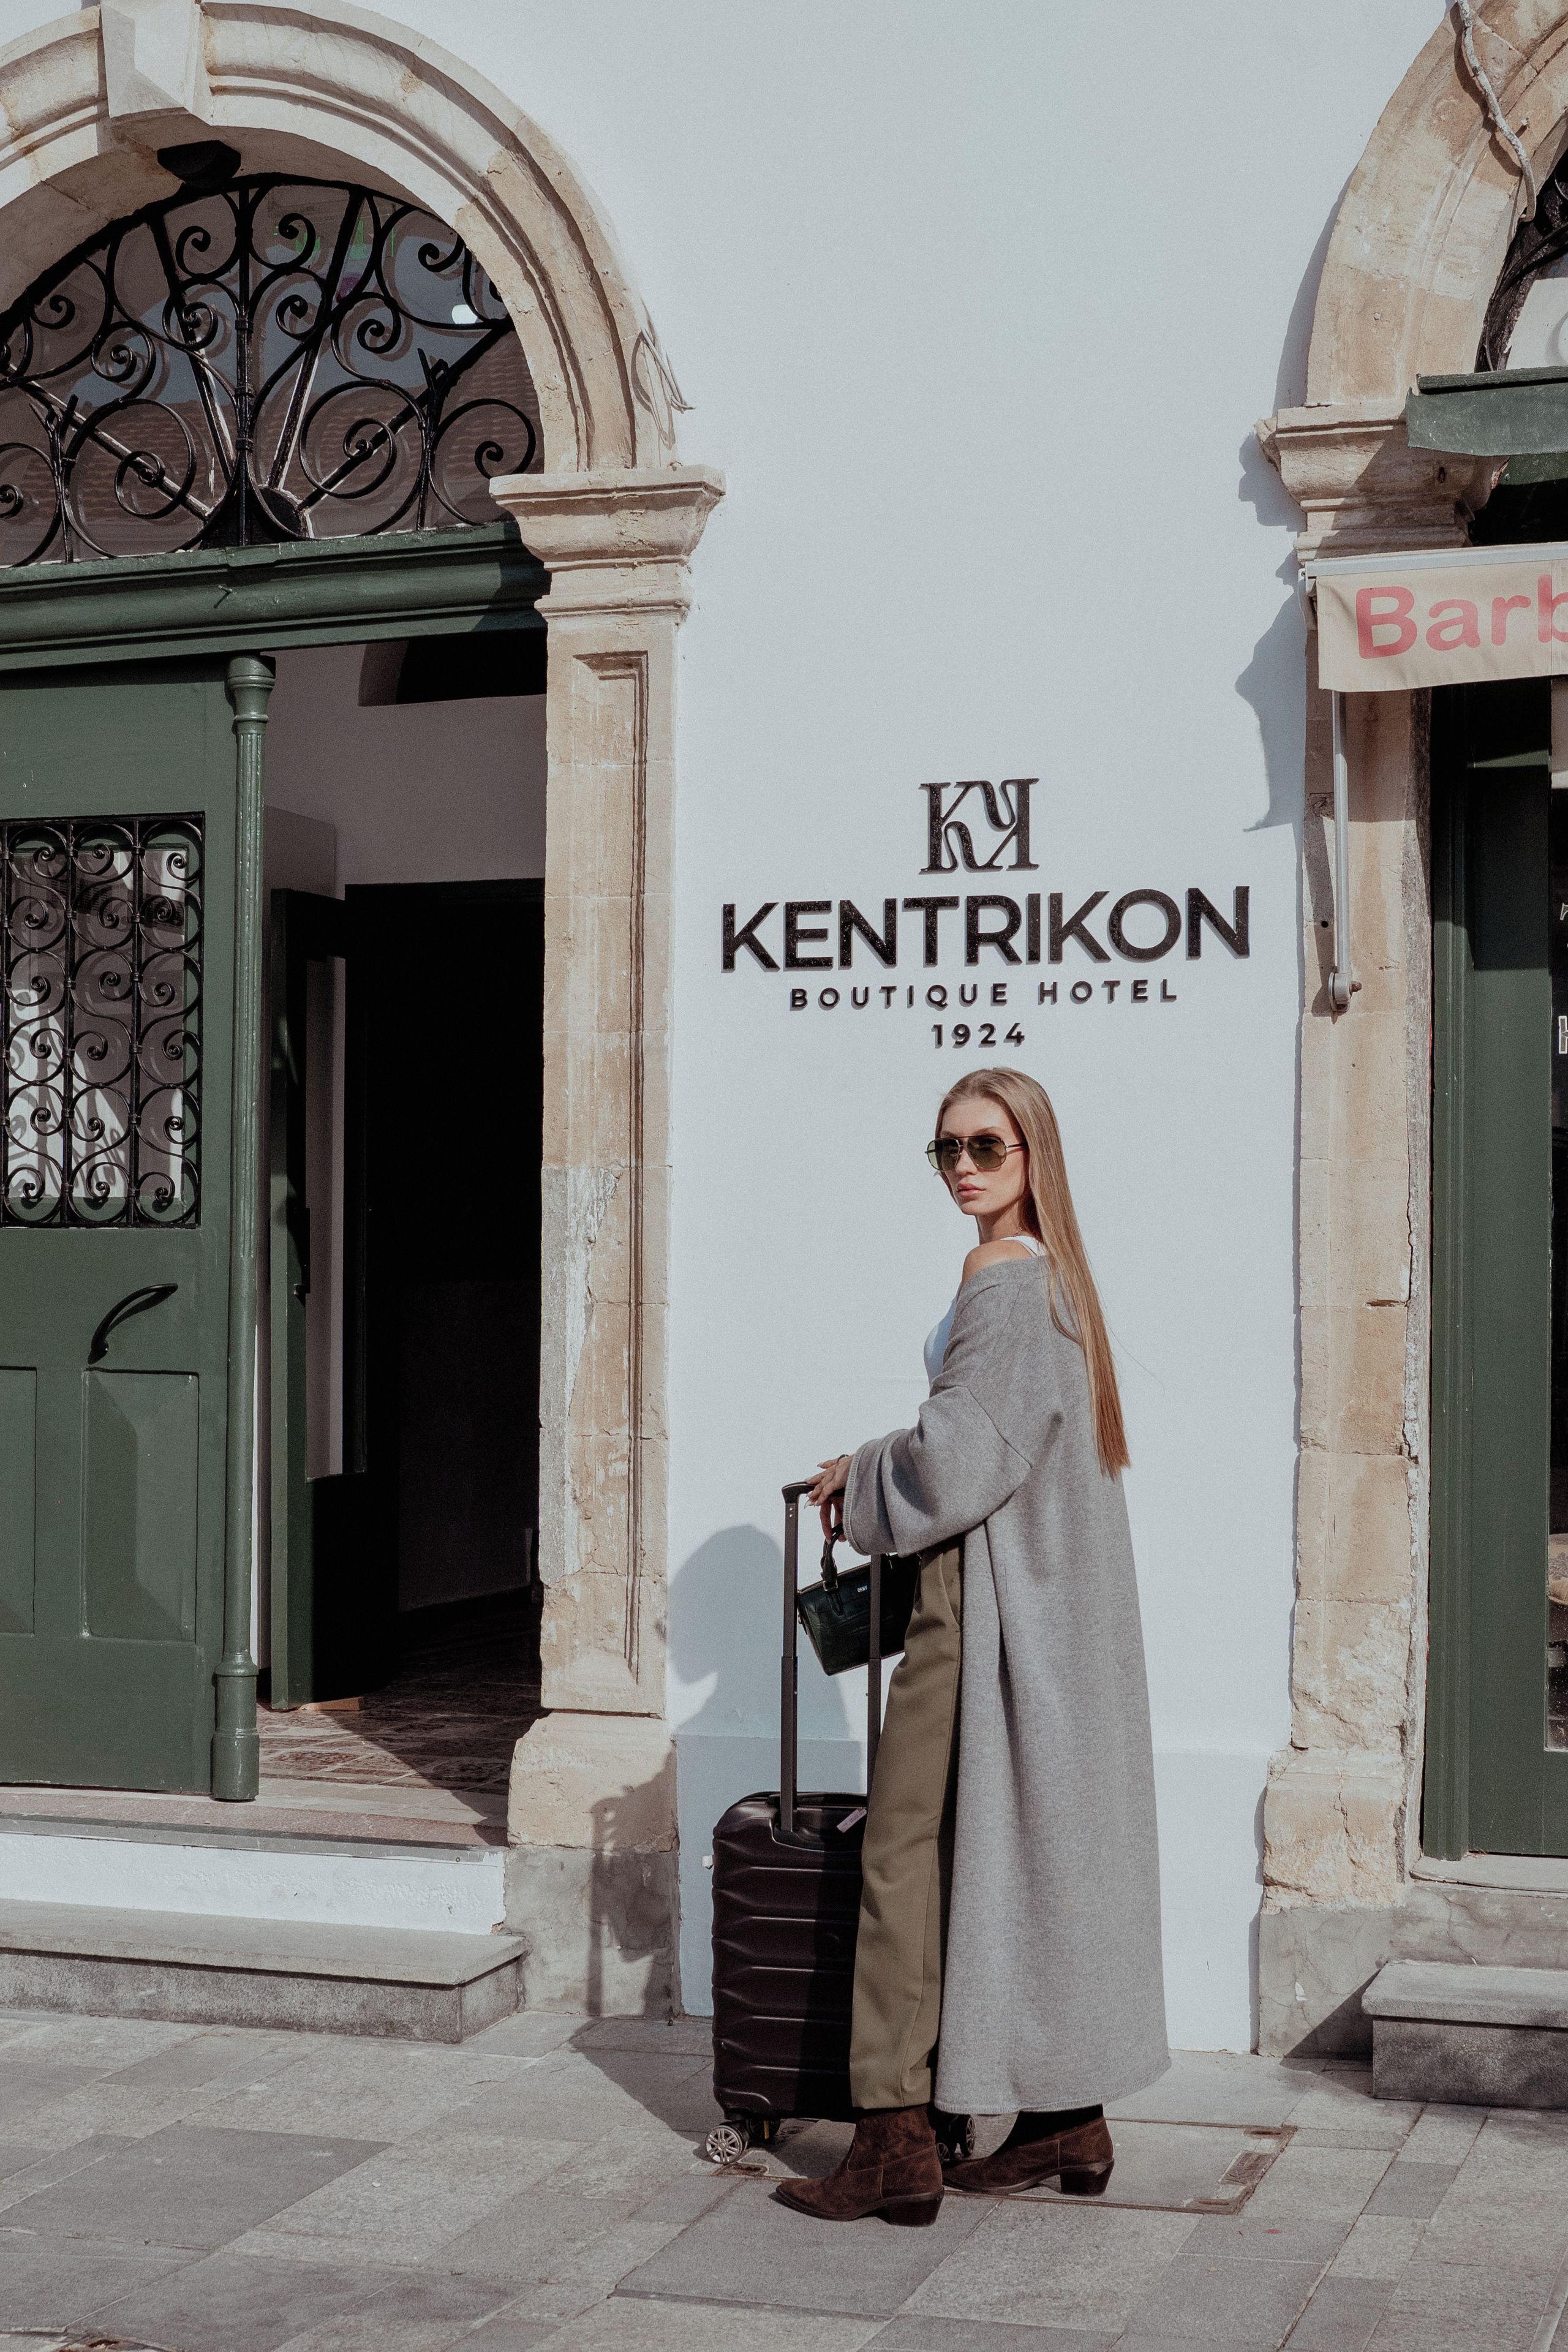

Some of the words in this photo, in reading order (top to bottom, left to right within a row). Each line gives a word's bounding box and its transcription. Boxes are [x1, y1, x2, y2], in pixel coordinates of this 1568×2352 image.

[722, 886, 1250, 971] KENTRIKON
[791, 982, 1008, 1009] BOUTIQUE
[1039, 979, 1177, 1003] HOTEL
[933, 1022, 1025, 1047] 1924
